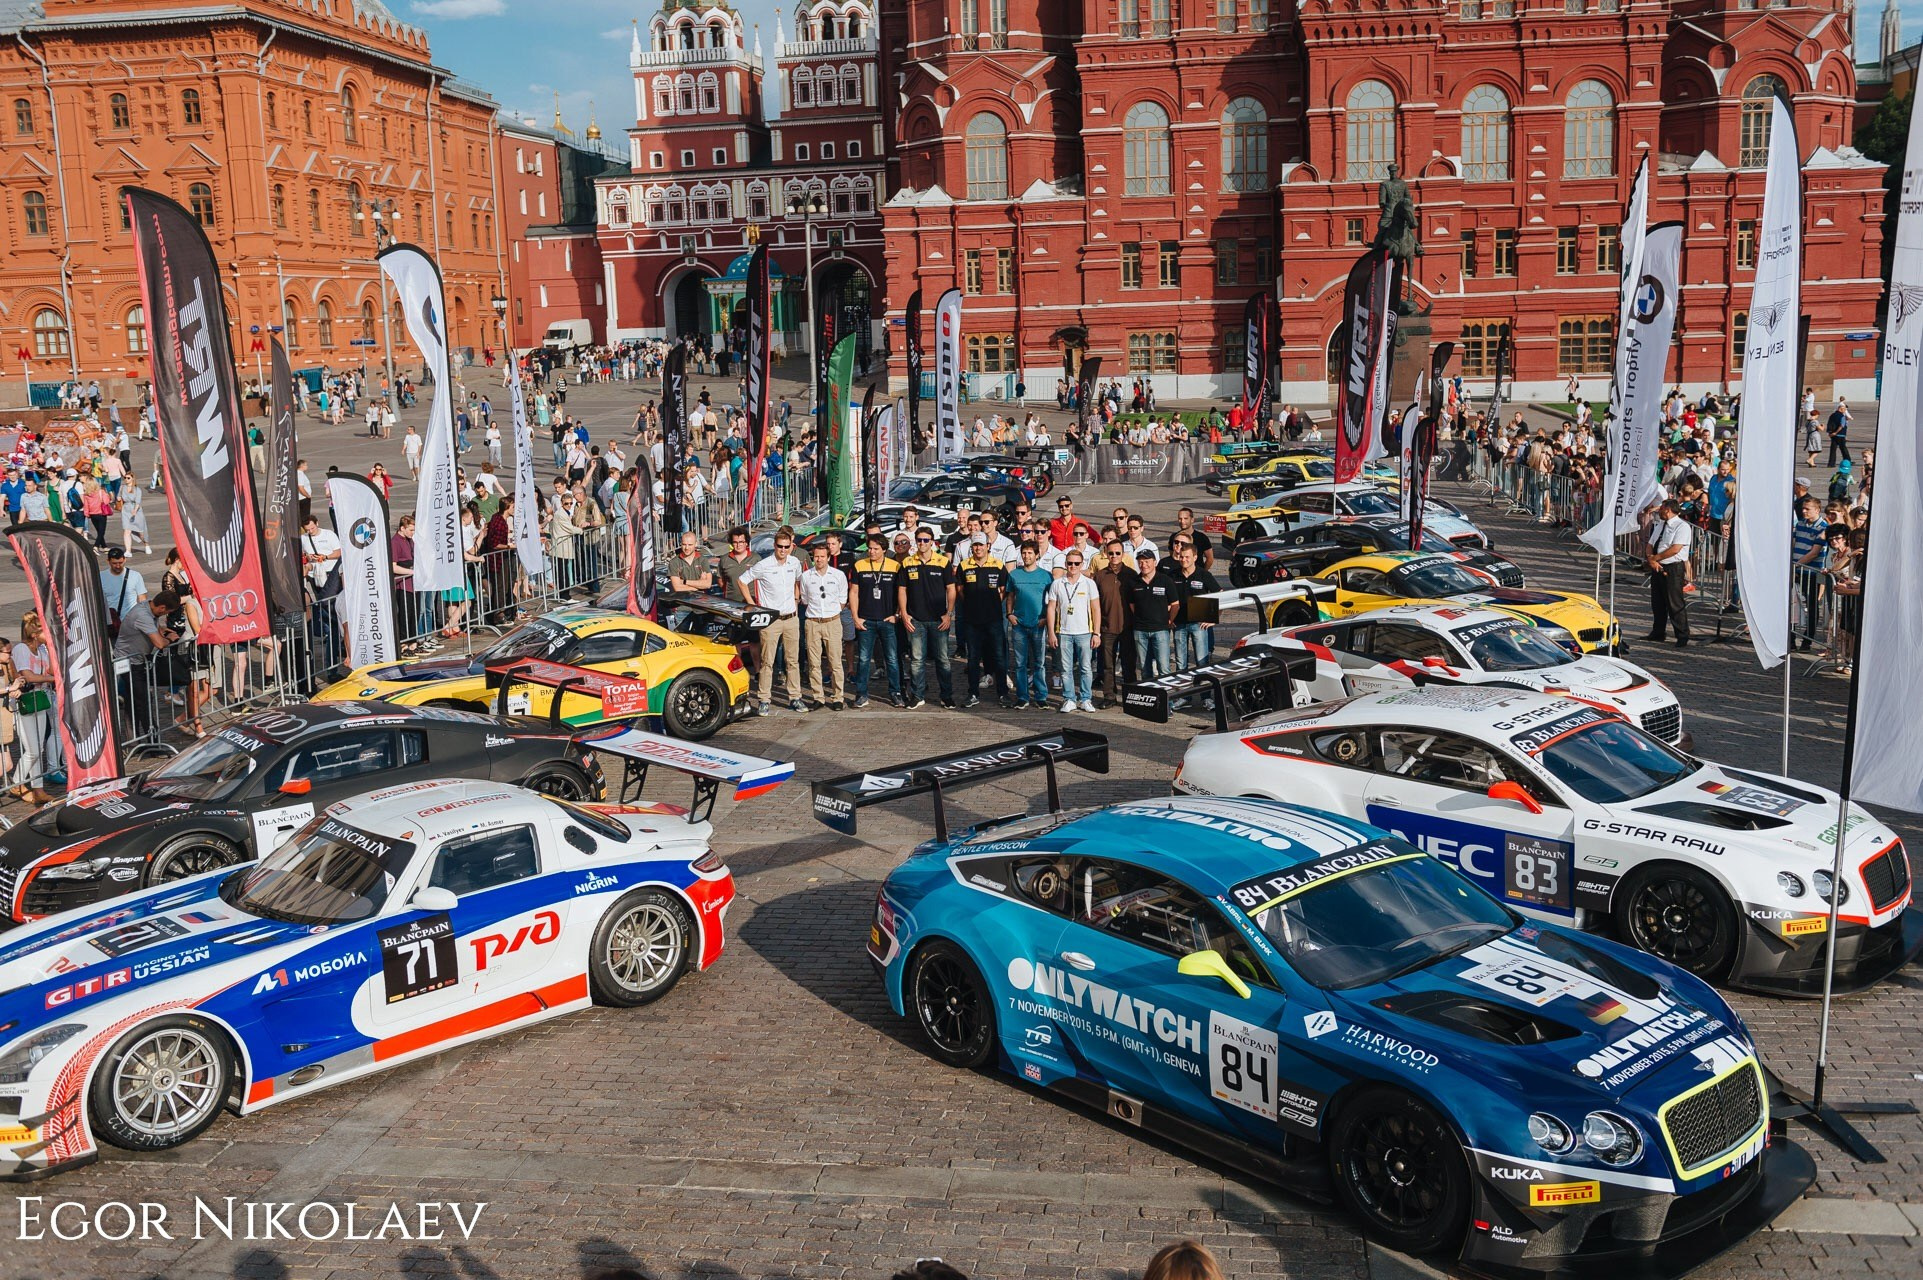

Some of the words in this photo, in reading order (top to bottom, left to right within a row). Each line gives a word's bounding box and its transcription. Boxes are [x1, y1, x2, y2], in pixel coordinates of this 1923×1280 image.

[750, 298, 762, 419] WRT
[1247, 318, 1258, 380] WRT
[1348, 294, 1369, 398] WRT
[942, 312, 954, 439] nismo
[1623, 338, 1642, 398] Trophy
[1620, 407, 1634, 463] Sports
[1112, 458, 1159, 466] BLANCPAIN
[1624, 474, 1637, 518] Team
[1631, 427, 1644, 472] Brasil
[834, 468, 843, 511] RACING
[1614, 467, 1627, 517] BMW
[1462, 632, 1470, 641] 6
[604, 682, 645, 695] TOTAL
[1362, 680, 1382, 690] support
[1540, 674, 1561, 684] 6
[1240, 726, 1277, 736] BENTLEY
[1279, 719, 1320, 730] MOSCOW
[1515, 739, 1540, 753] 83
[1529, 711, 1603, 742] BLANCPAIN
[258, 811, 311, 827] BLANCPAIN
[813, 805, 850, 819] MOTORSPORT
[320, 821, 391, 858] BLANCPAIN
[951, 843, 989, 855] BENTLEY
[990, 841, 1030, 850] MOSCOW
[1508, 842, 1565, 860] BLANCPAIN
[1583, 819, 1667, 842] G-STAR
[1671, 835, 1726, 856] RAW
[112, 855, 145, 864] Snap-on
[1390, 828, 1494, 878] NEC
[575, 875, 618, 895] NIGRIN
[1233, 884, 1271, 906] 84
[1265, 844, 1398, 896] BLANCPAIN
[1515, 854, 1558, 895] 83
[1576, 886, 1609, 895] MOTORSPORT
[1751, 910, 1793, 919] KUKA
[1786, 919, 1822, 932] PIRELLI
[382, 921, 450, 948] BLANCPAIN
[134, 954, 176, 969] RACING
[178, 945, 209, 956] TEAM
[294, 951, 367, 982] МОБОЙЛ
[397, 938, 438, 985] 71
[1472, 957, 1523, 981] BLANCPAIN
[1494, 965, 1568, 994] 84
[1008, 957, 1201, 1055] ONLYWATCH
[1009, 997, 1015, 1009] 7
[1017, 998, 1070, 1024] NOVEMBER
[1071, 1017, 1094, 1037] 2015,
[1095, 1025, 1101, 1037] 5
[1103, 1030, 1120, 1045] P.M.
[1122, 1036, 1162, 1063] (GMT+1),
[1163, 1053, 1202, 1077] GENEVA
[1025, 1028, 1052, 1045] TTS
[1213, 1023, 1277, 1055] BLANCPAIN
[1346, 1024, 1439, 1069] HARWOOD
[1025, 1063, 1040, 1073] LIQUI
[1341, 1036, 1431, 1074] INTERNATIONAL
[1600, 1081, 1611, 1091] 7
[1610, 1057, 1654, 1087] NOVEMBER
[1648, 1046, 1673, 1067] 2015,
[1669, 1043, 1678, 1051] 5
[1025, 1069, 1041, 1080] MOLY
[1221, 1043, 1269, 1104] 84
[1279, 1096, 1316, 1113] MOTORSPORT
[1491, 1167, 1544, 1180] KUKA
[1537, 1185, 1593, 1202] PIRELLI
[1491, 1225, 1513, 1236] ALD
[1491, 1233, 1528, 1244] Automotive
